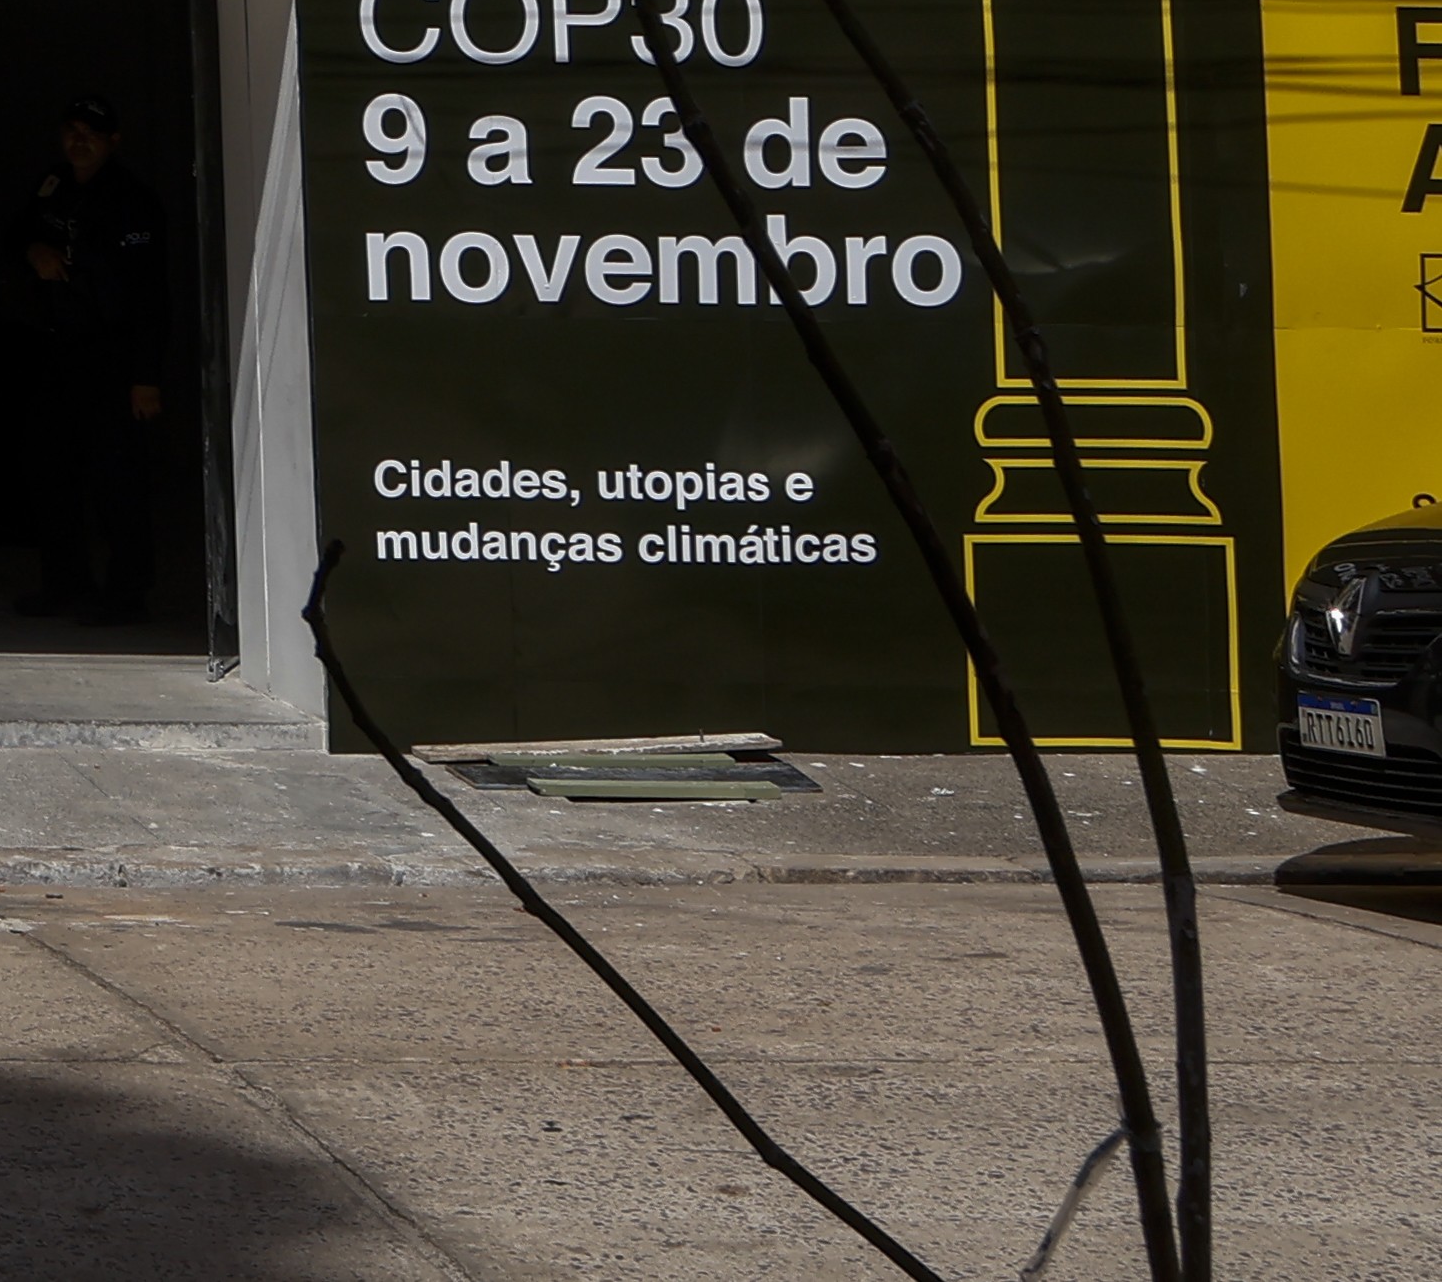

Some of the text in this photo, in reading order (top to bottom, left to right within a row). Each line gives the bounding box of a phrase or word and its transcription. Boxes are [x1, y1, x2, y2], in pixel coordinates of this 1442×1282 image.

[362, 92, 887, 189] 9 a 23 de
[365, 213, 962, 307] novembro
[374, 459, 814, 511] Cidades, utopias e
[376, 521, 877, 572] mudanças climáticas
